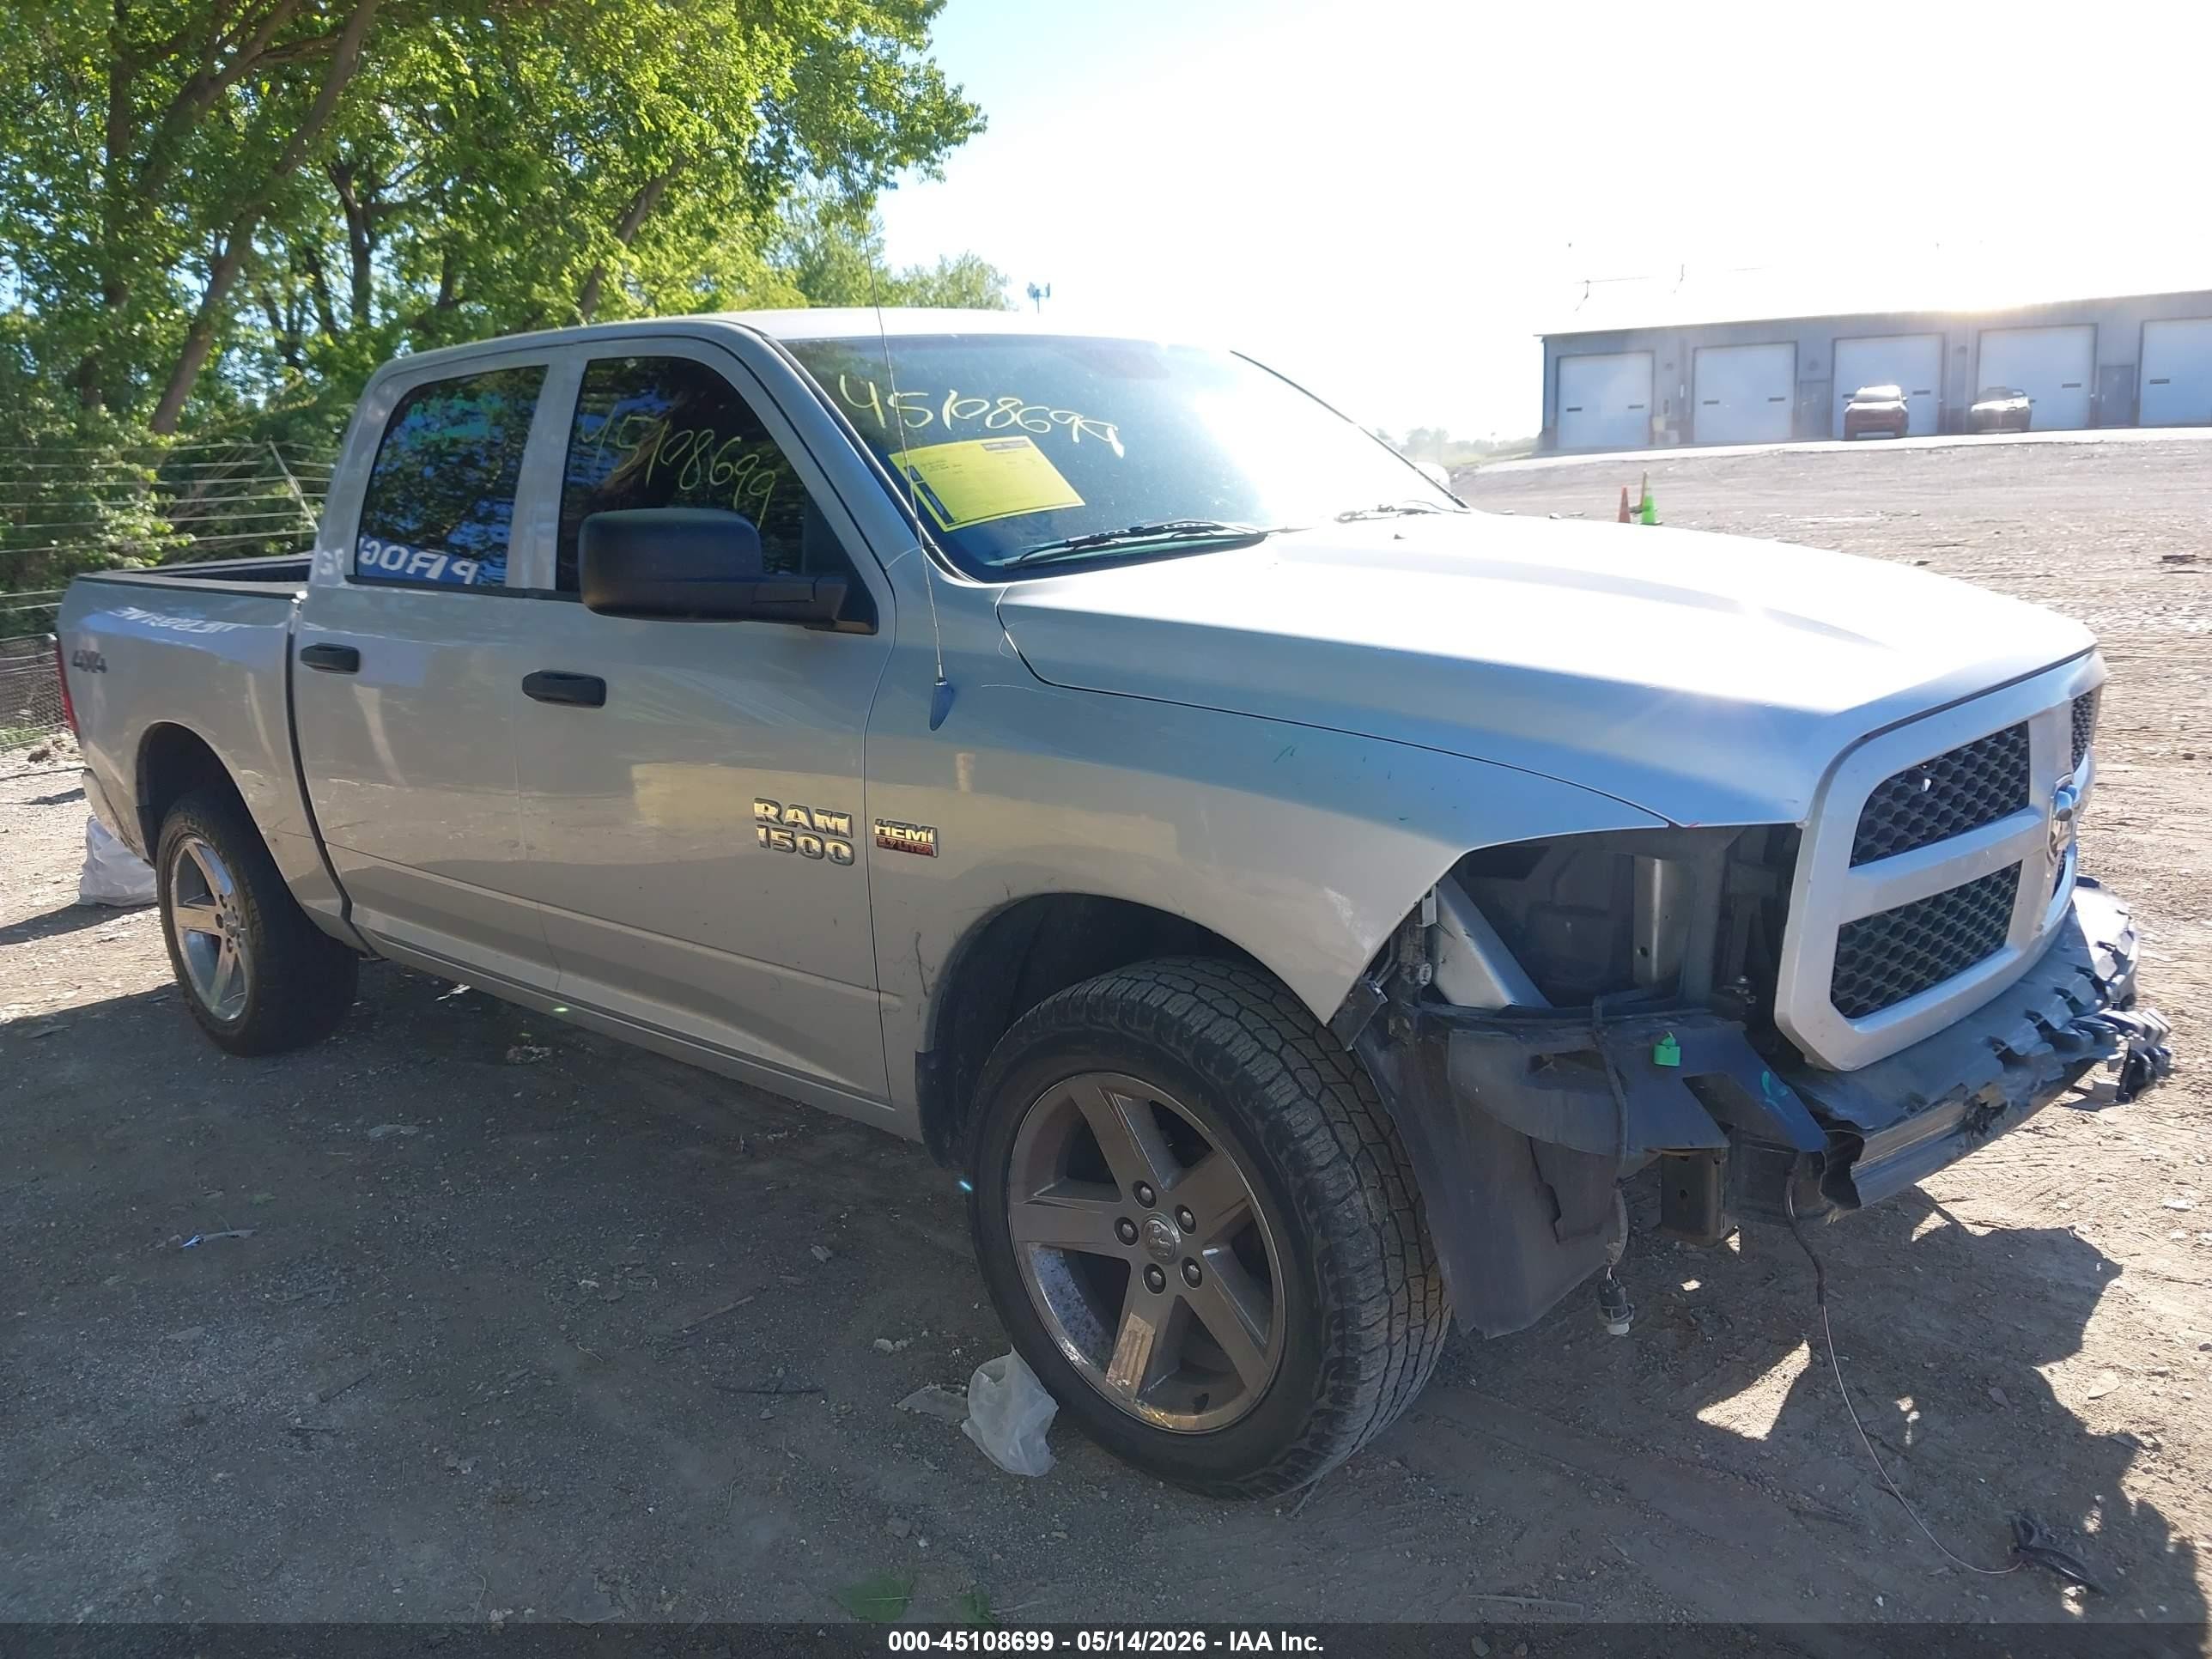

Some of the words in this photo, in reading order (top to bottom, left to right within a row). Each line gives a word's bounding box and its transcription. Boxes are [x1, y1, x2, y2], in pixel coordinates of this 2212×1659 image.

[839, 374, 1125, 458] 45108699
[754, 797, 854, 839] RAM
[874, 818, 938, 844] HEMI
[756, 824, 855, 866] 1500
